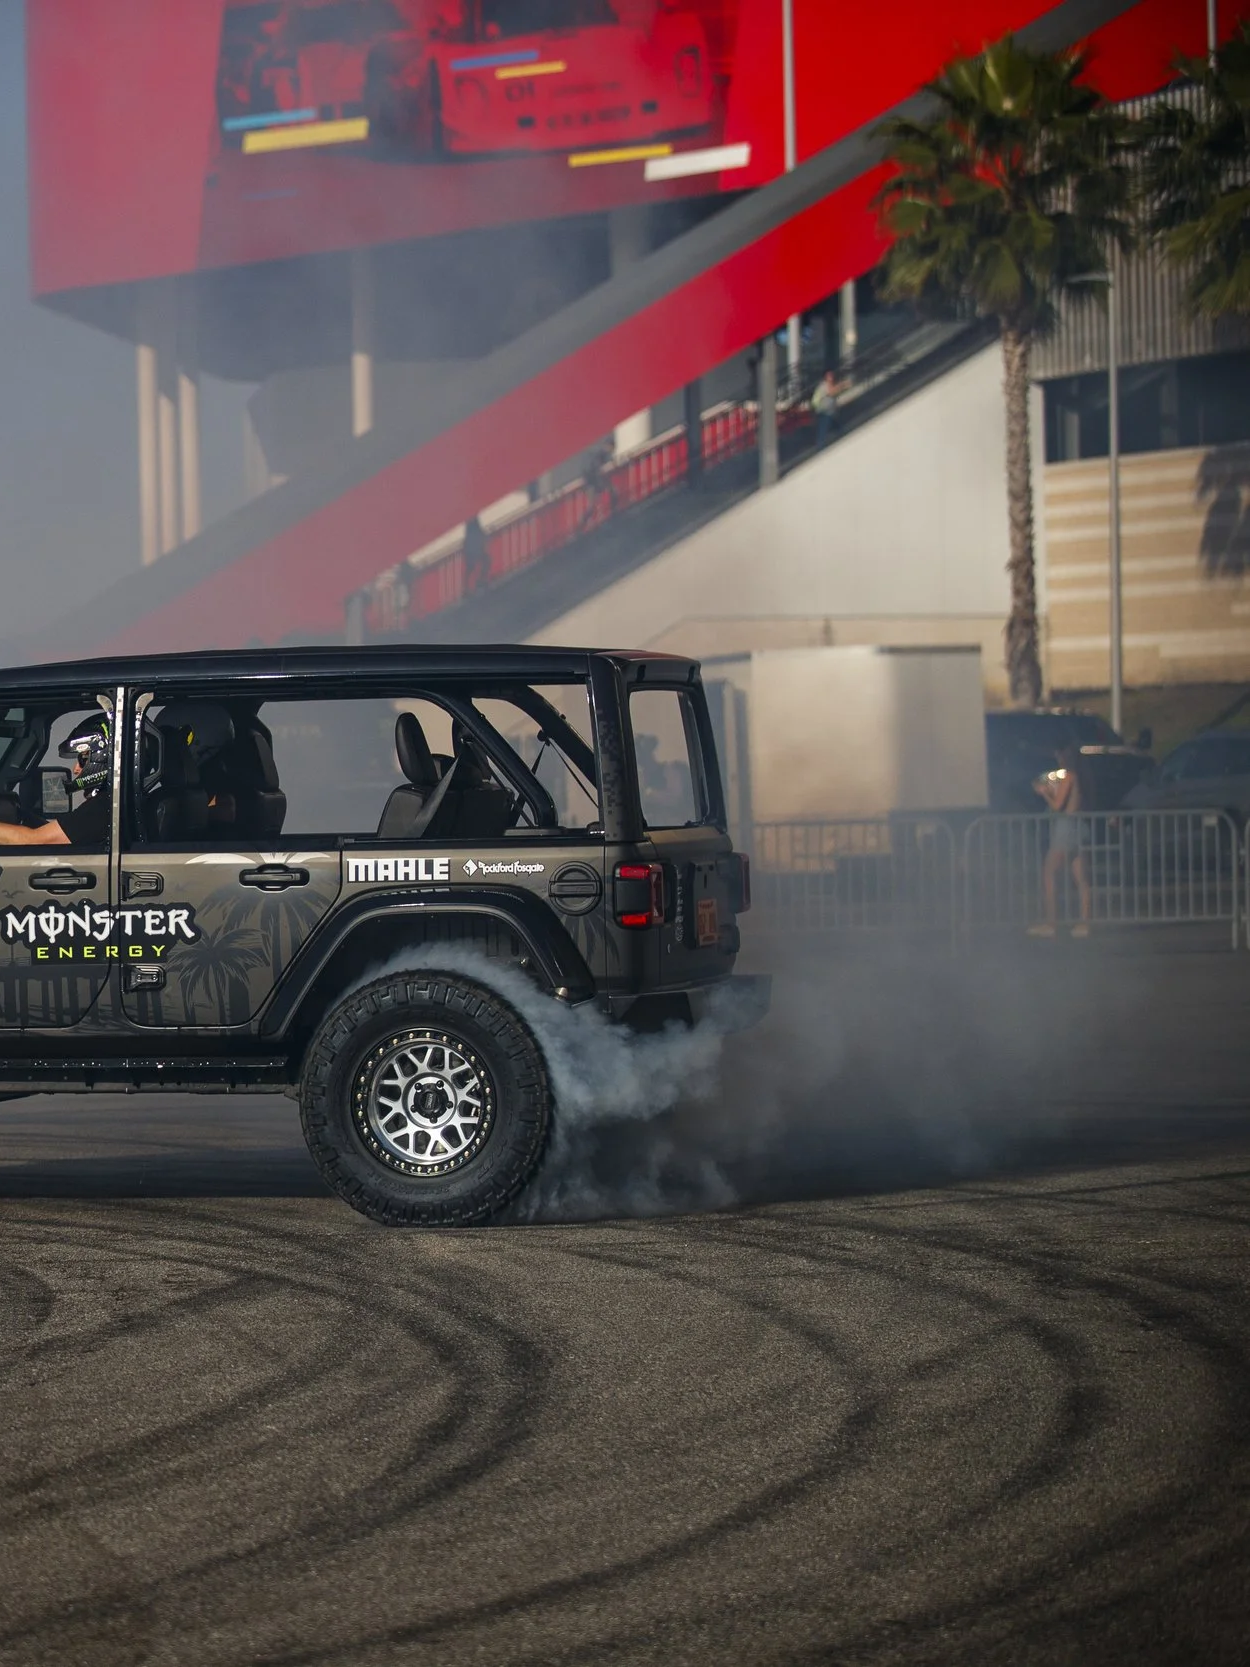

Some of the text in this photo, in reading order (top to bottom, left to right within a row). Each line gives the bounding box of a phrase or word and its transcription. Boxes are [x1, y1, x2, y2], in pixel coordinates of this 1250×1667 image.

[347, 858, 449, 882] MAHLE
[478, 860, 545, 876] Rockford Fosgate
[5, 905, 196, 944] MONSTER
[36, 945, 166, 959] ENERGY
